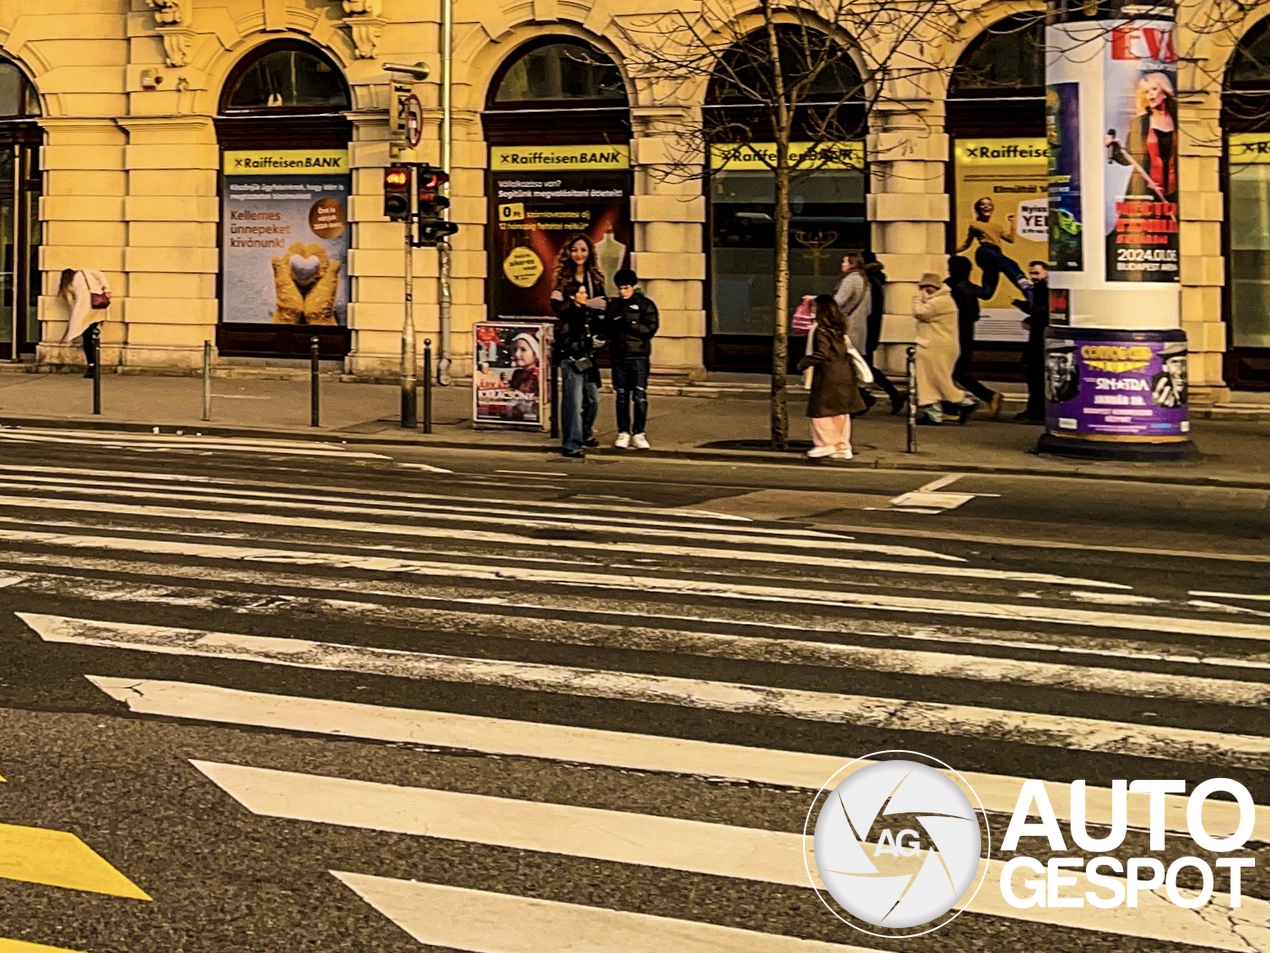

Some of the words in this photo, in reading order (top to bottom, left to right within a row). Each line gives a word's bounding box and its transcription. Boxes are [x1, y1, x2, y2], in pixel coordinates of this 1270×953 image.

[230, 211, 281, 220] Kellemes
[503, 207, 511, 217] 0
[231, 224, 291, 235] ünnepeket
